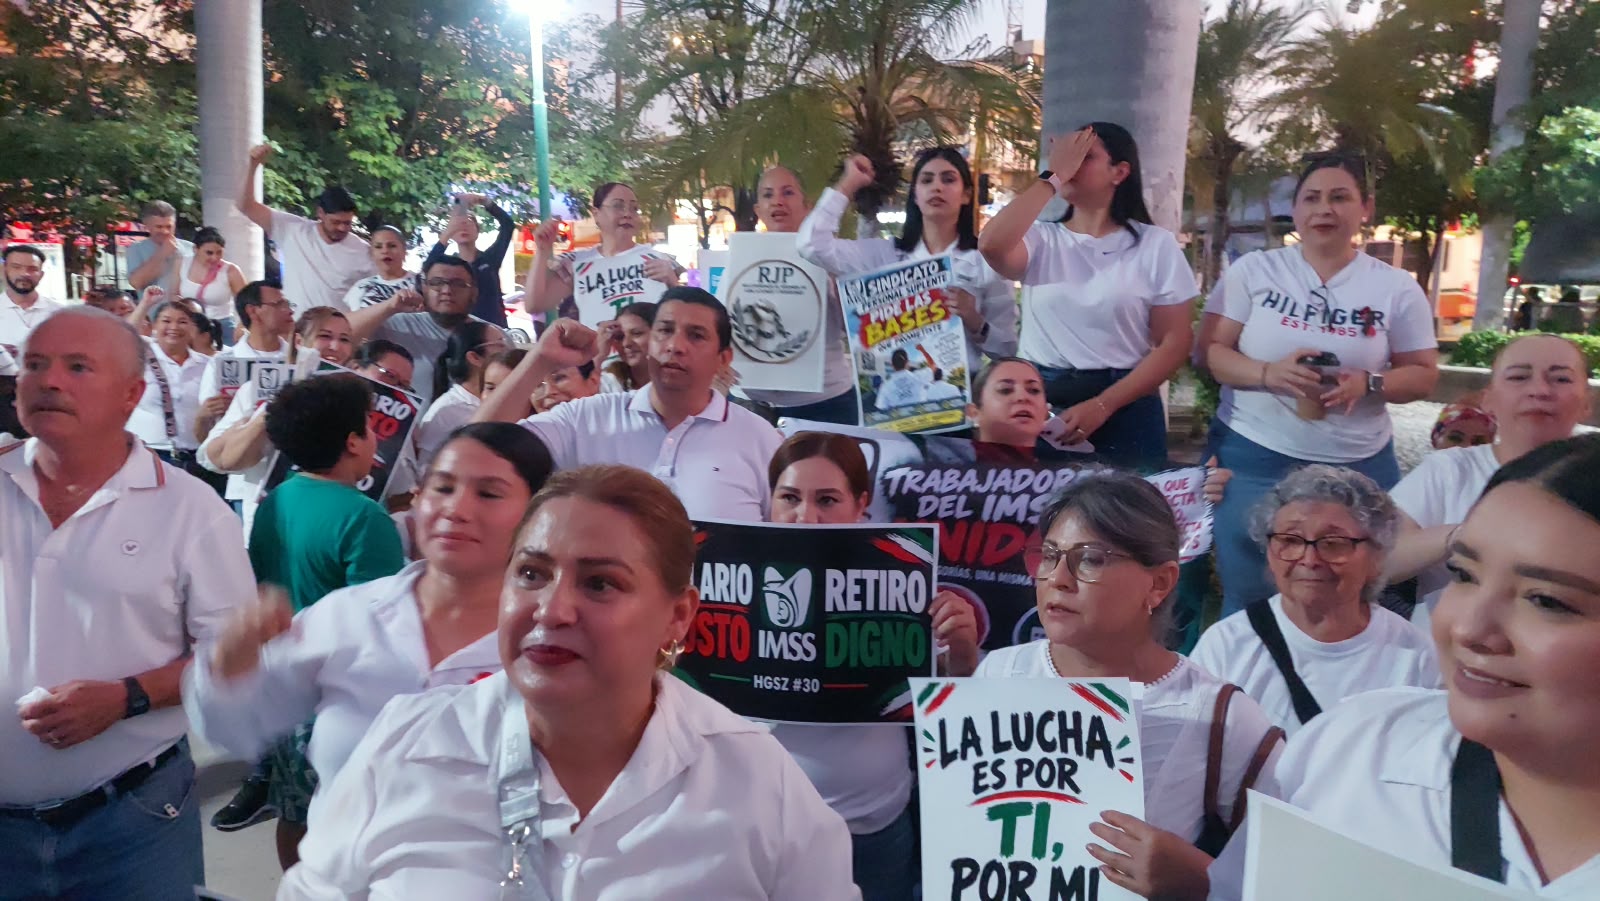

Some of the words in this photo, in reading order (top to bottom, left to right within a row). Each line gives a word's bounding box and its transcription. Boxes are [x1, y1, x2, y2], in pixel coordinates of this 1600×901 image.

[586, 273, 606, 293] LA
[608, 264, 647, 283] LUCH
[602, 286, 616, 299] ES
[620, 280, 644, 293] POR
[867, 261, 940, 297] SINDICATO
[865, 299, 946, 348] BASES
[869, 301, 902, 323] PIDE
[904, 292, 932, 312] LAS
[1262, 290, 1385, 327] HILFIGER
[1164, 477, 1189, 493] QUE
[916, 494, 974, 519] DEL
[825, 569, 927, 613] RETIRO
[975, 569, 996, 582] UNA
[758, 629, 817, 662] IMSS
[825, 621, 926, 668] DIGNO
[753, 675, 790, 692] HGSZ
[793, 678, 820, 693] #30
[938, 716, 984, 769] LA
[990, 710, 1115, 769] LUCHA
[972, 759, 1006, 795] ES
[1015, 757, 1081, 794] POR
[985, 801, 1064, 862] TI,
[950, 857, 1037, 901] POR
